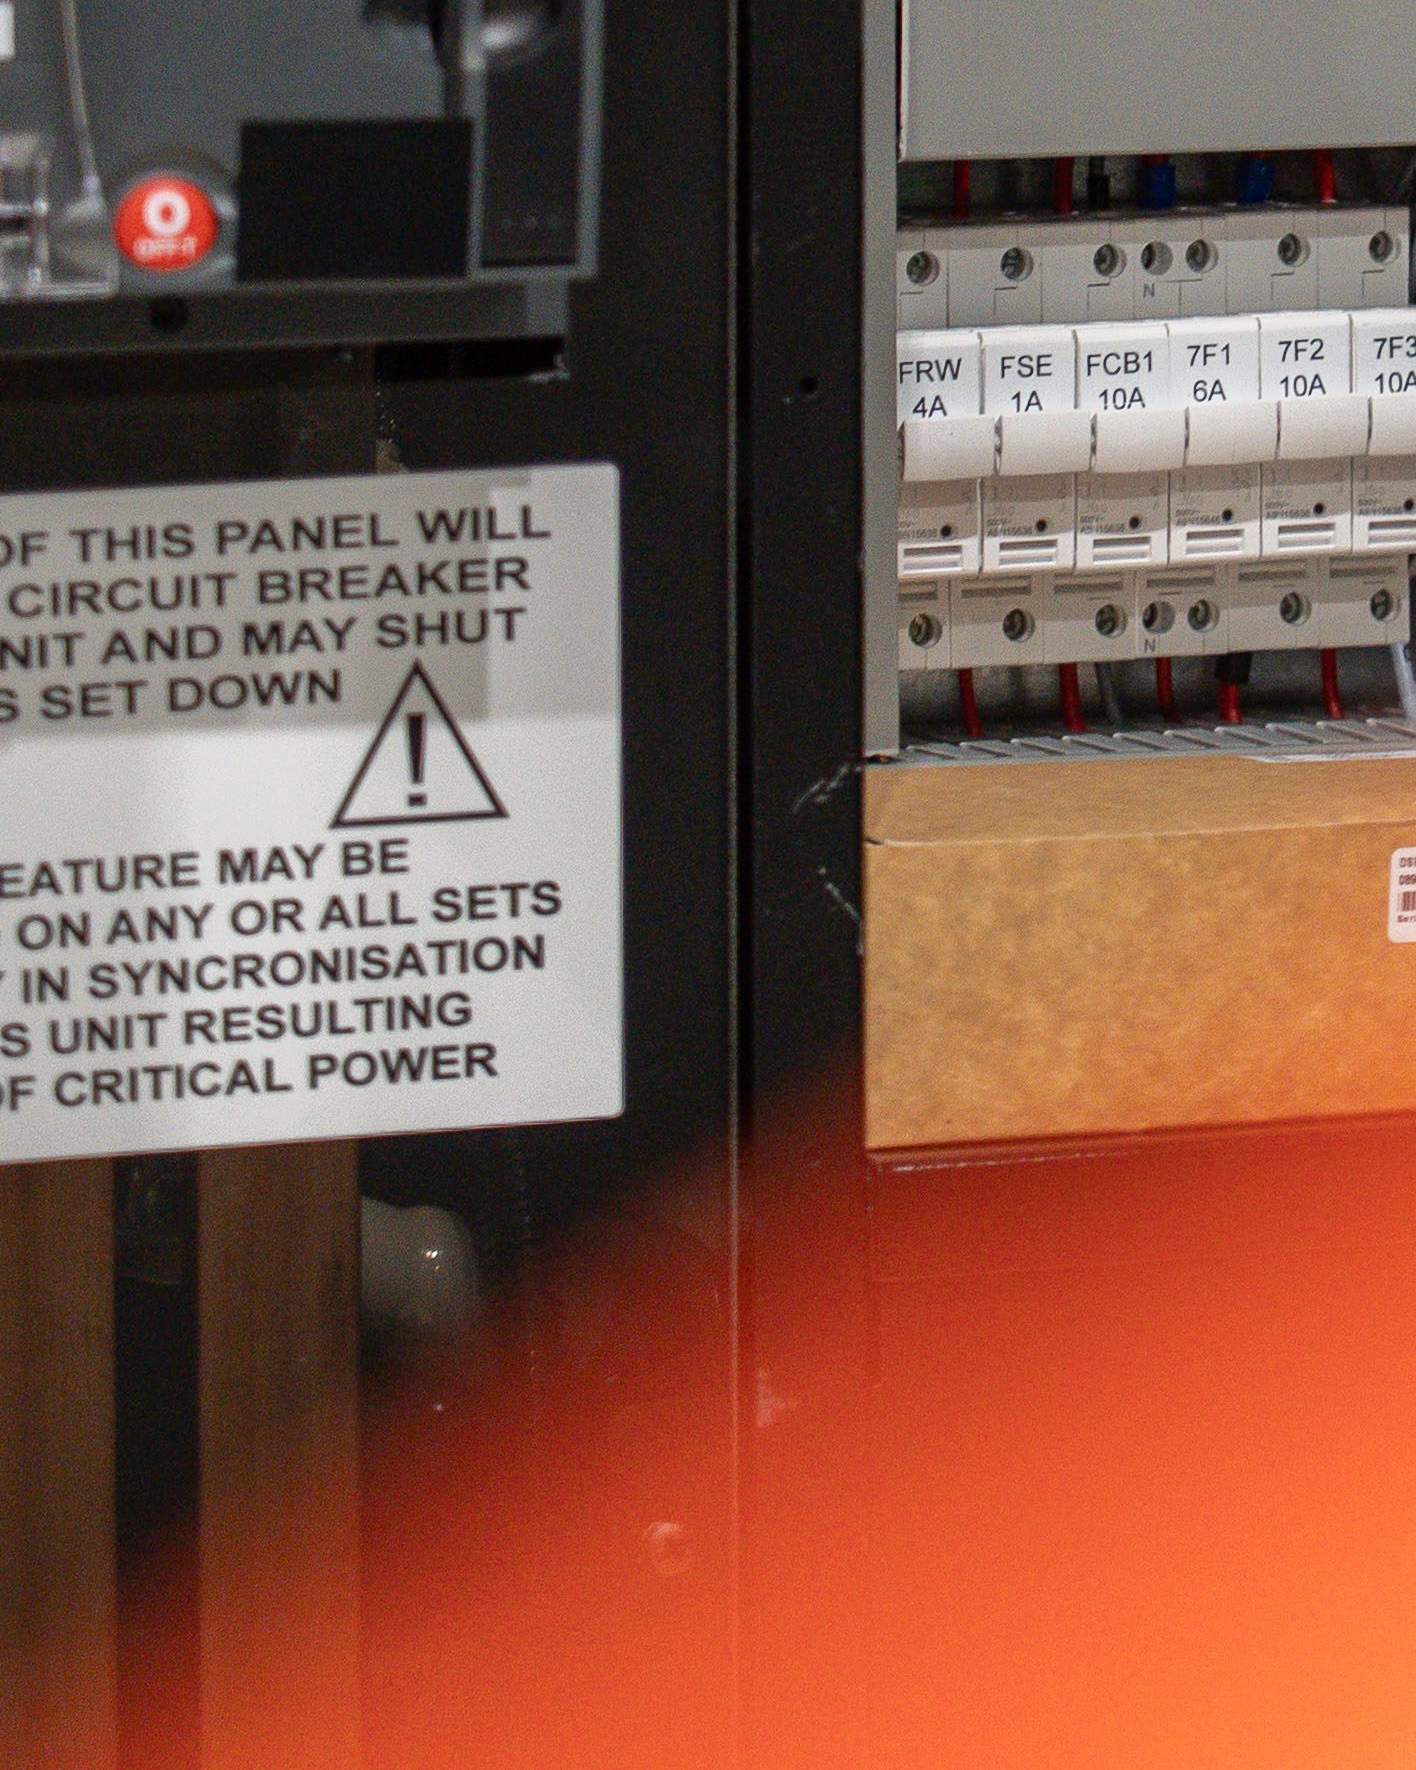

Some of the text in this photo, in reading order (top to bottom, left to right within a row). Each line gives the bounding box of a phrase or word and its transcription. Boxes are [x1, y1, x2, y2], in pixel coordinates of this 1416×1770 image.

[1187, 343, 1230, 366] 7F1
[1278, 338, 1324, 362] 7F2
[899, 358, 962, 384] FRW
[1001, 354, 1052, 378] FSE
[1087, 351, 1152, 376] FCB1
[1099, 386, 1145, 410] 10A
[1193, 379, 1226, 402] 6A
[1280, 373, 1326, 397] 10A
[912, 395, 947, 417] 4A
[1012, 390, 1042, 412] 1A
[70, 523, 195, 563] THIS
[216, 513, 398, 555] PANEL
[415, 505, 550, 544] WILL
[7, 557, 529, 618] CIRCUIT BREAKER
[0, 608, 524, 671] NIT AND MAY SHUT
[41, 680, 146, 720] SET
[168, 669, 341, 712] DOWN
[0, 838, 408, 900] EATURE MAY BE
[17, 880, 562, 951] ON ANY OR ALL SETS
[23, 935, 545, 1003] IN SYNCRONISATION
[0, 991, 472, 1058] S UNIT RESULTING
[0, 1043, 498, 1111] F CRITICAL POWER
